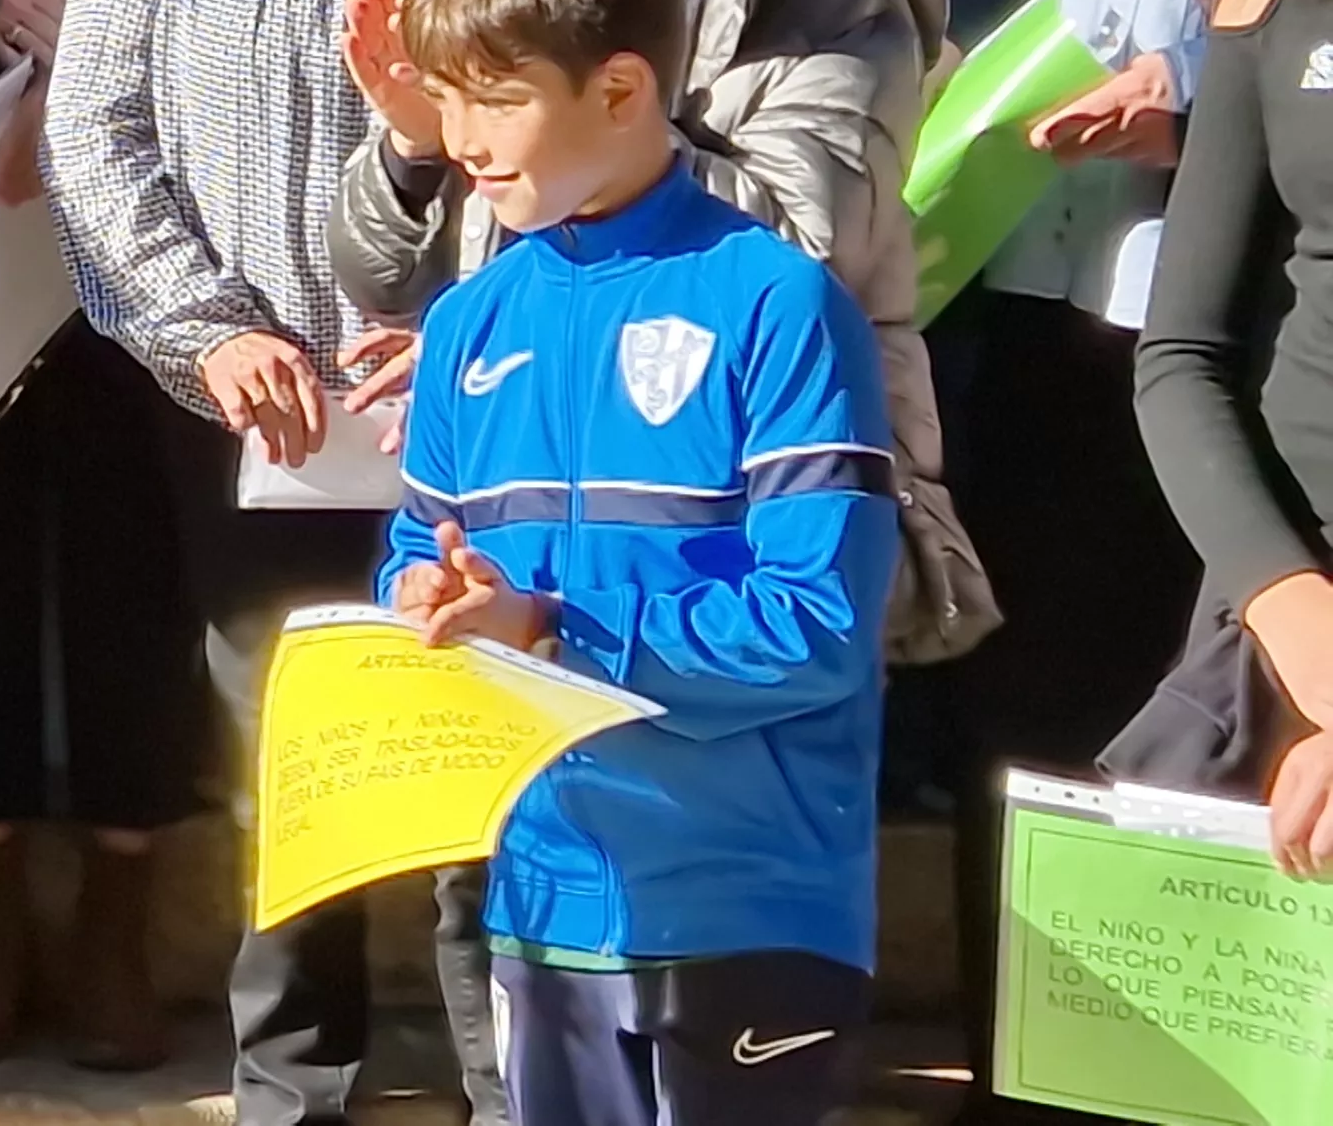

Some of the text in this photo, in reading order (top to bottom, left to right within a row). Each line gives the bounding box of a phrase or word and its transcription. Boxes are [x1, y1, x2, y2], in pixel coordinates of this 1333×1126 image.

[1159, 875, 1299, 916] ARTÍCULO
[1050, 909, 1083, 934] EL
[1097, 916, 1165, 947] NIÑO
[1181, 930, 1201, 951] Y
[1215, 935, 1249, 963] LA
[1048, 936, 1183, 977] DERECHO
[1202, 960, 1223, 984] A
[1048, 962, 1084, 988] LO
[1102, 971, 1162, 999] QUE
[1046, 989, 1134, 1022] MEDIO
[1140, 1005, 1200, 1033] QUE
